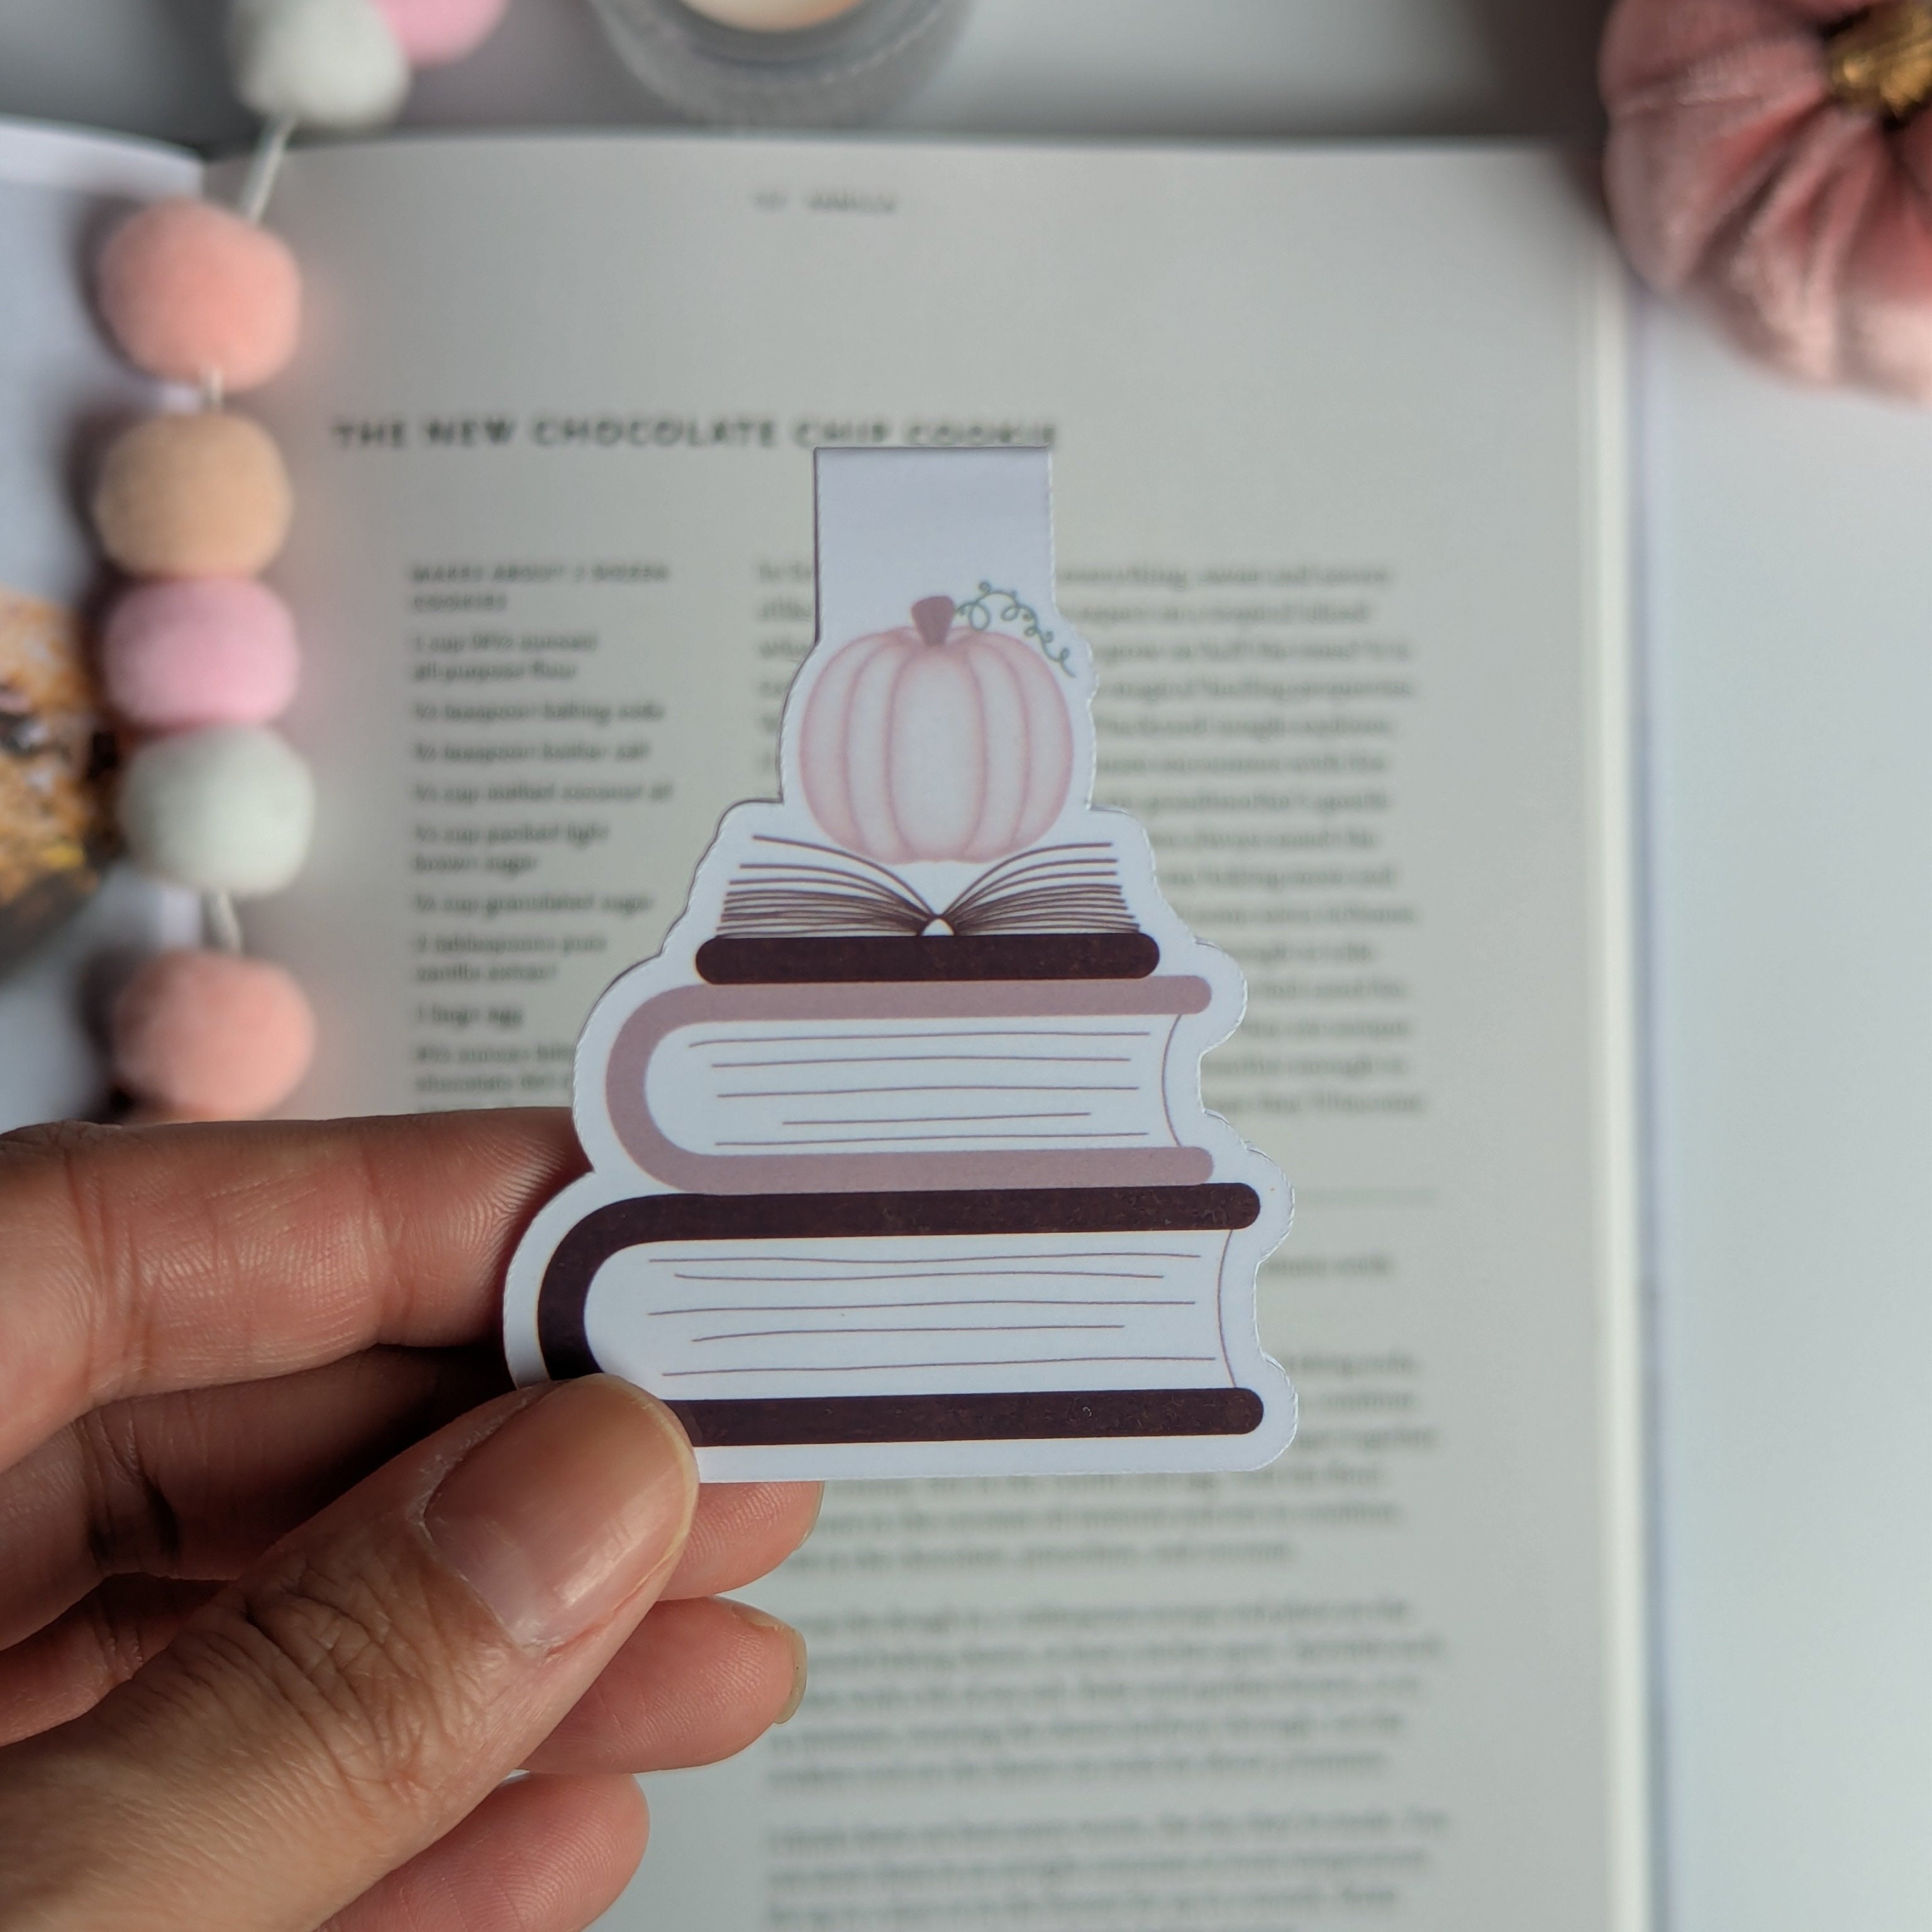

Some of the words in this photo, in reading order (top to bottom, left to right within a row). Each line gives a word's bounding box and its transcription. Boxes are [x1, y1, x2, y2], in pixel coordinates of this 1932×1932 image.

[335, 419, 406, 448] THE
[425, 419, 516, 447] NEW
[533, 419, 775, 447] CHOCOLATE
[794, 419, 891, 449] CHIP
[908, 421, 1057, 447] COOKIE
